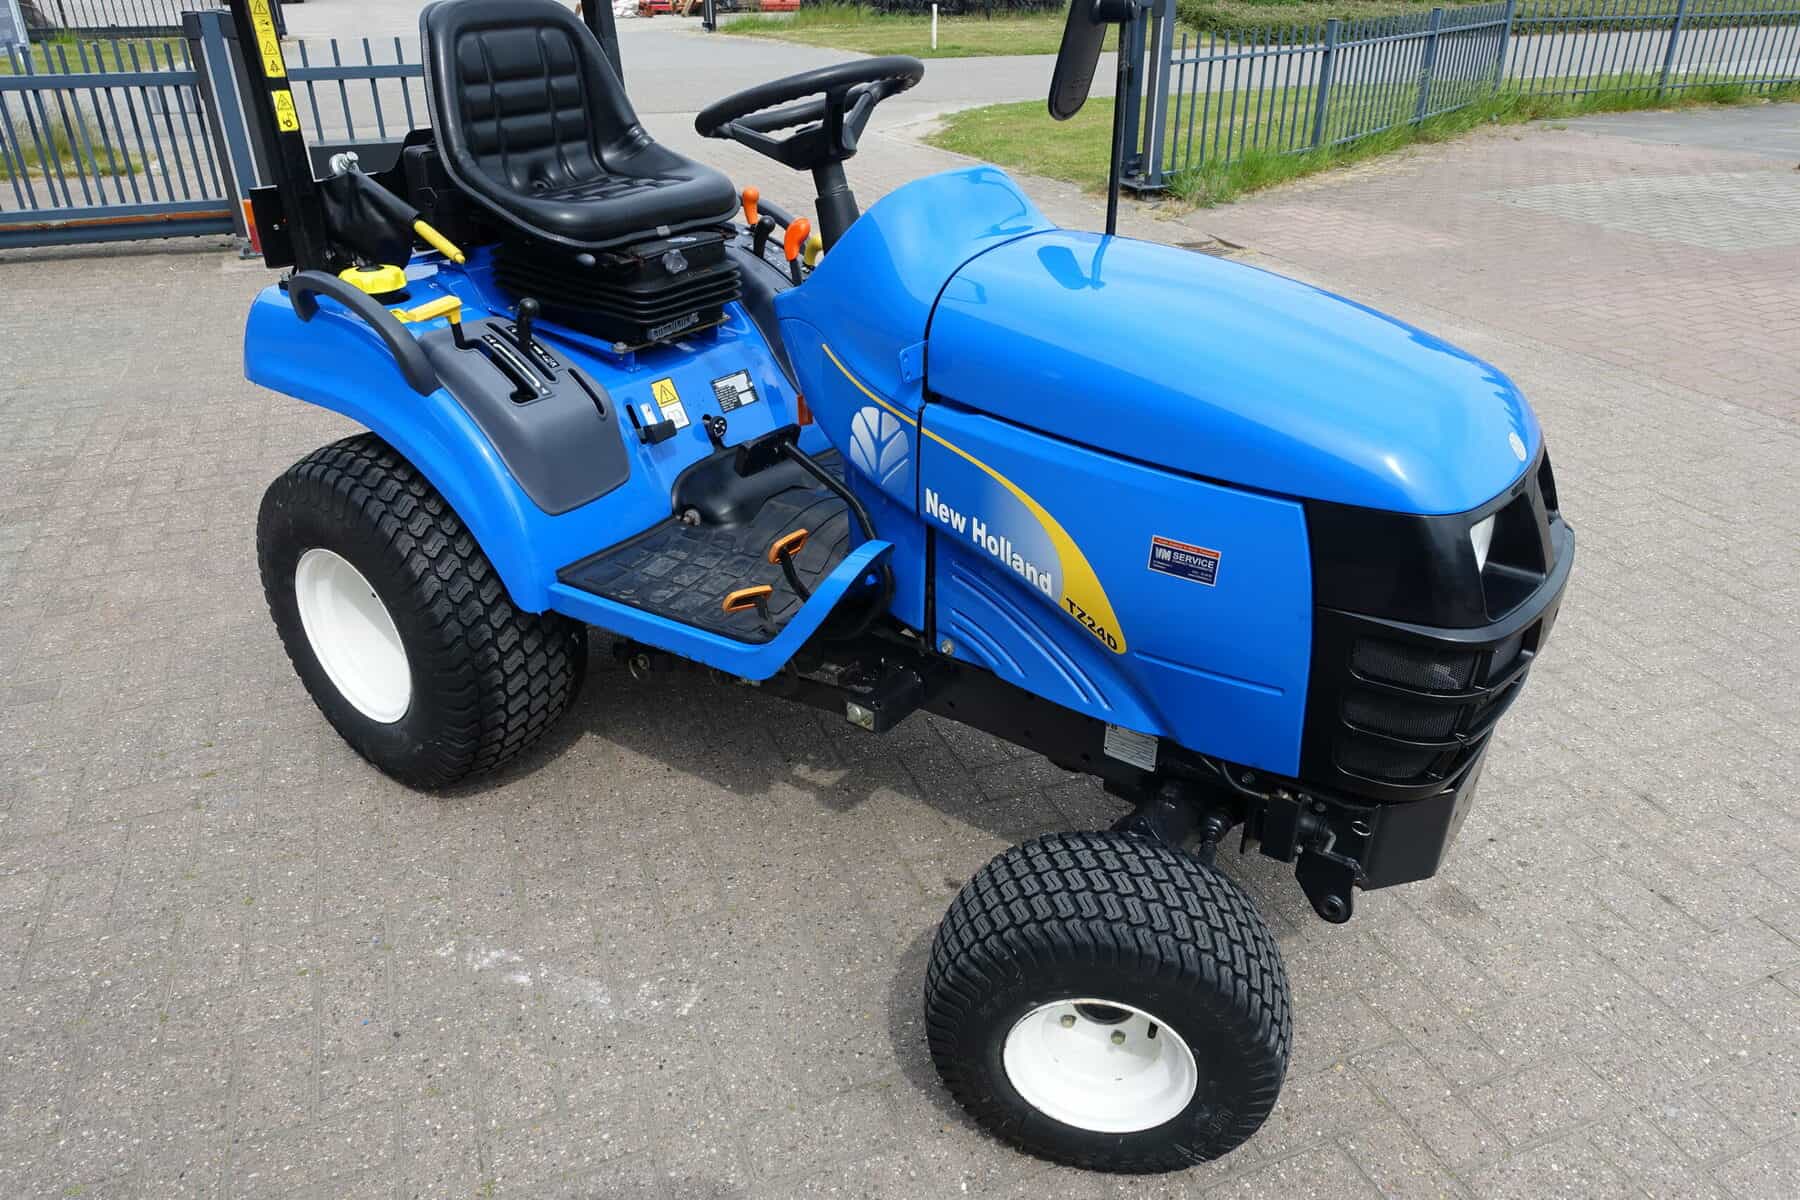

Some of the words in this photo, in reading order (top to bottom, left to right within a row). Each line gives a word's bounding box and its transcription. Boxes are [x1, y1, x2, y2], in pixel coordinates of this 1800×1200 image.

[926, 488, 966, 534] New
[972, 517, 1052, 597] Holland
[1172, 552, 1215, 569] SERVICE
[1065, 597, 1118, 651] TZ24D
